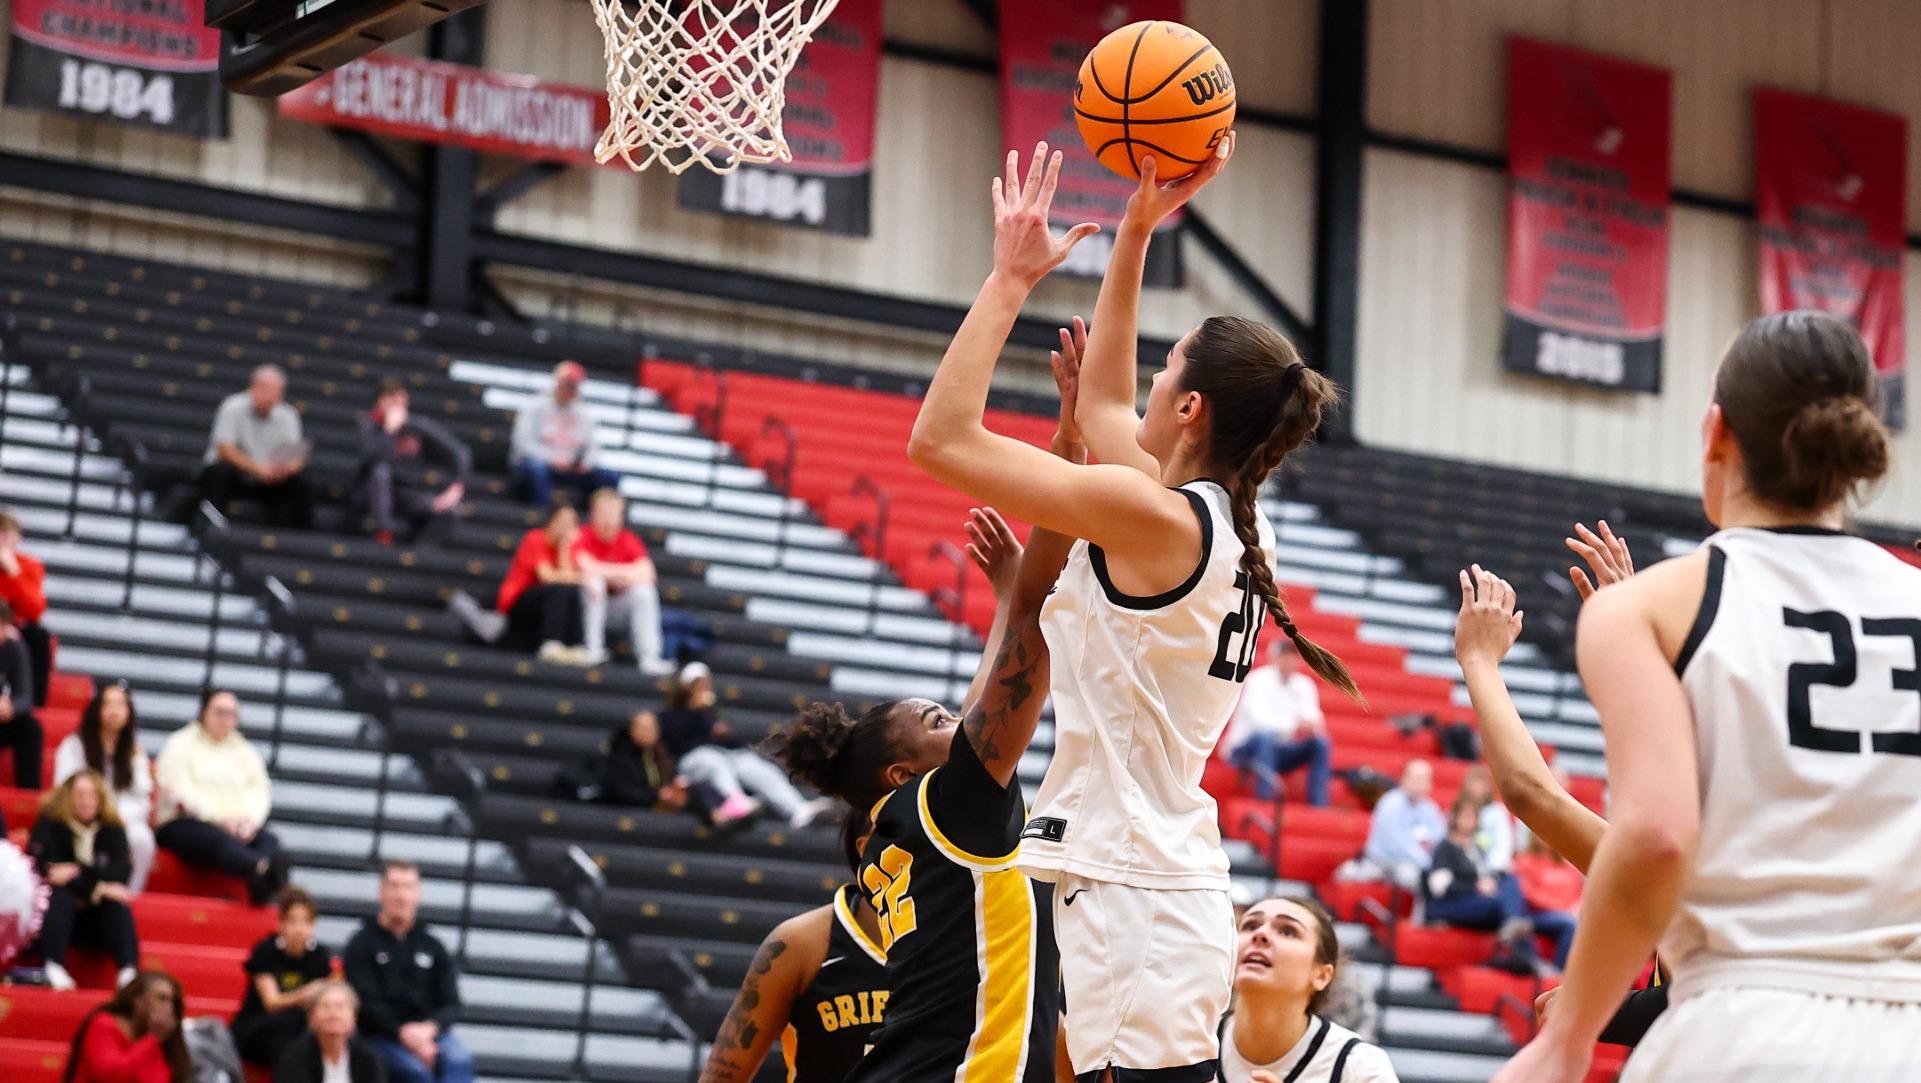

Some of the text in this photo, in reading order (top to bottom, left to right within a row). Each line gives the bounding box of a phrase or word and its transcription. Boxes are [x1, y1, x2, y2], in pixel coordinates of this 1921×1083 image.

[59, 59, 174, 125] 1984
[333, 58, 595, 150] GENERAL ADMISSION
[1208, 569, 1266, 684] 20
[1782, 606, 1921, 757] 23
[1049, 824, 1056, 835] L
[863, 843, 917, 953] 22
[816, 989, 892, 1033] GRIF
